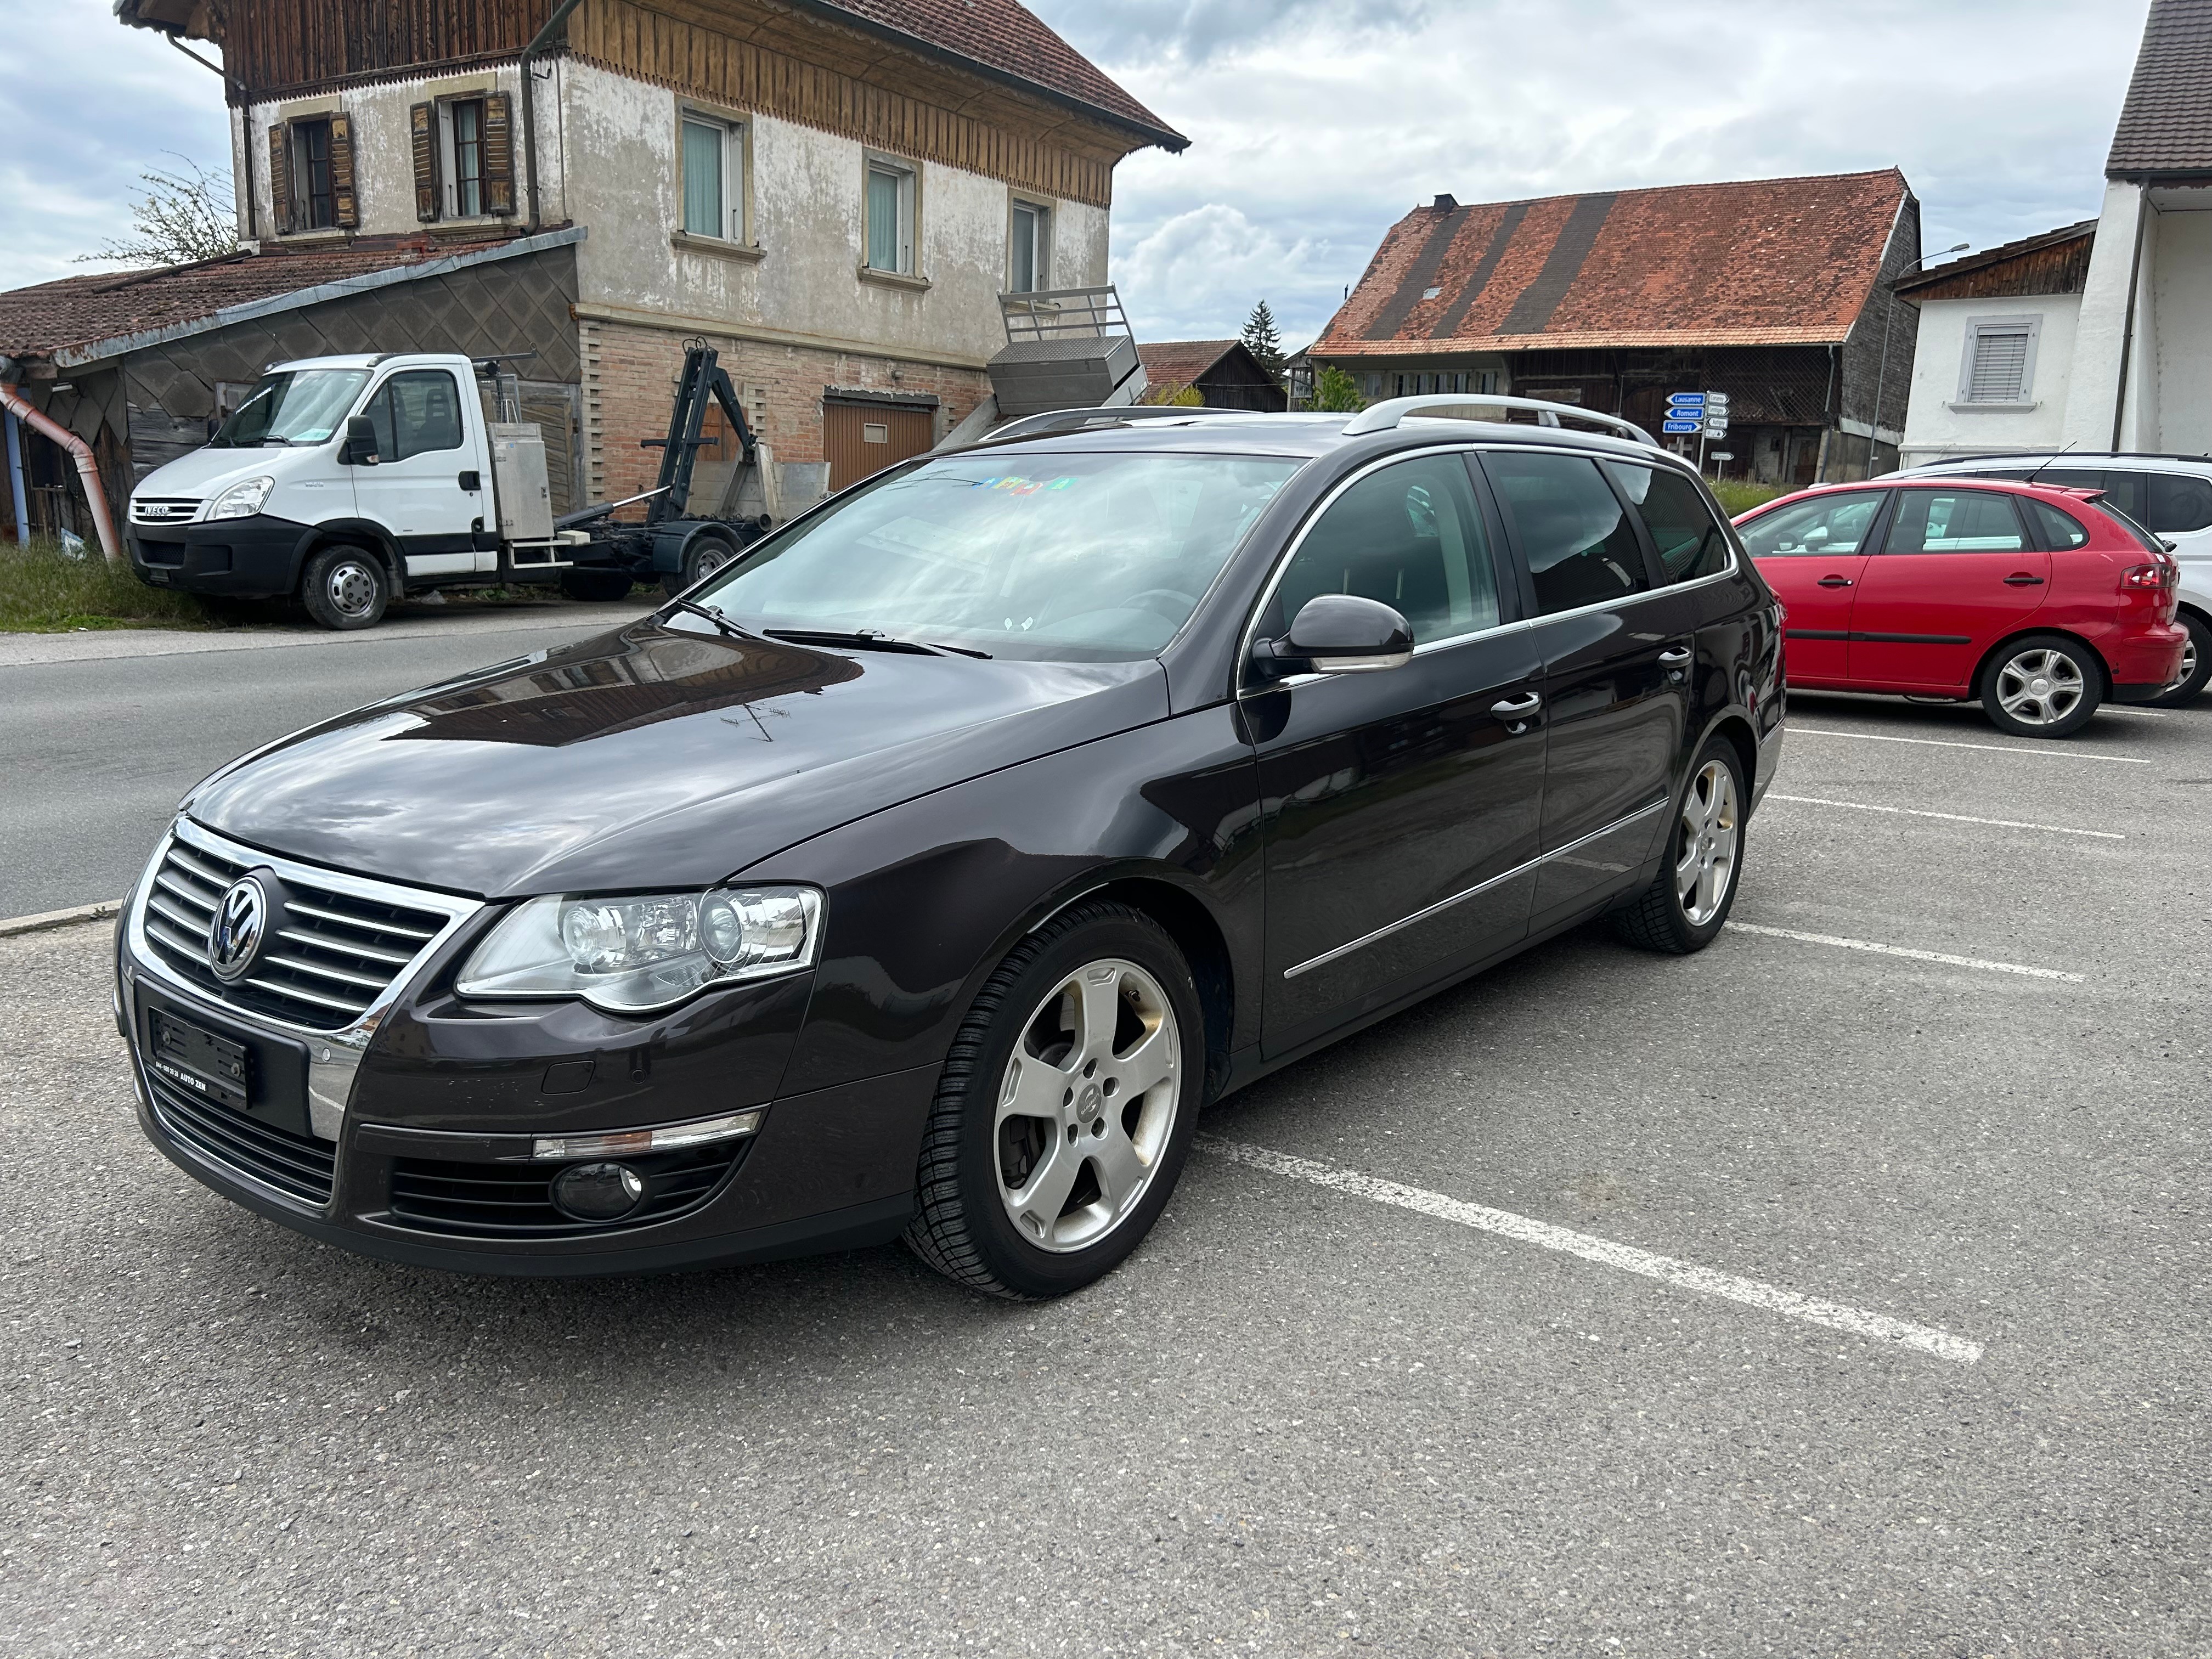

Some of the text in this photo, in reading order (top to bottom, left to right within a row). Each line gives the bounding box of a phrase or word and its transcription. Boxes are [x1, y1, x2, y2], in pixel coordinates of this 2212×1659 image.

[1668, 423, 1692, 431] Fribourg
[144, 506, 169, 515] IVECO
[180, 1073, 194, 1085] AUTO
[195, 1080, 206, 1091] ZEN
